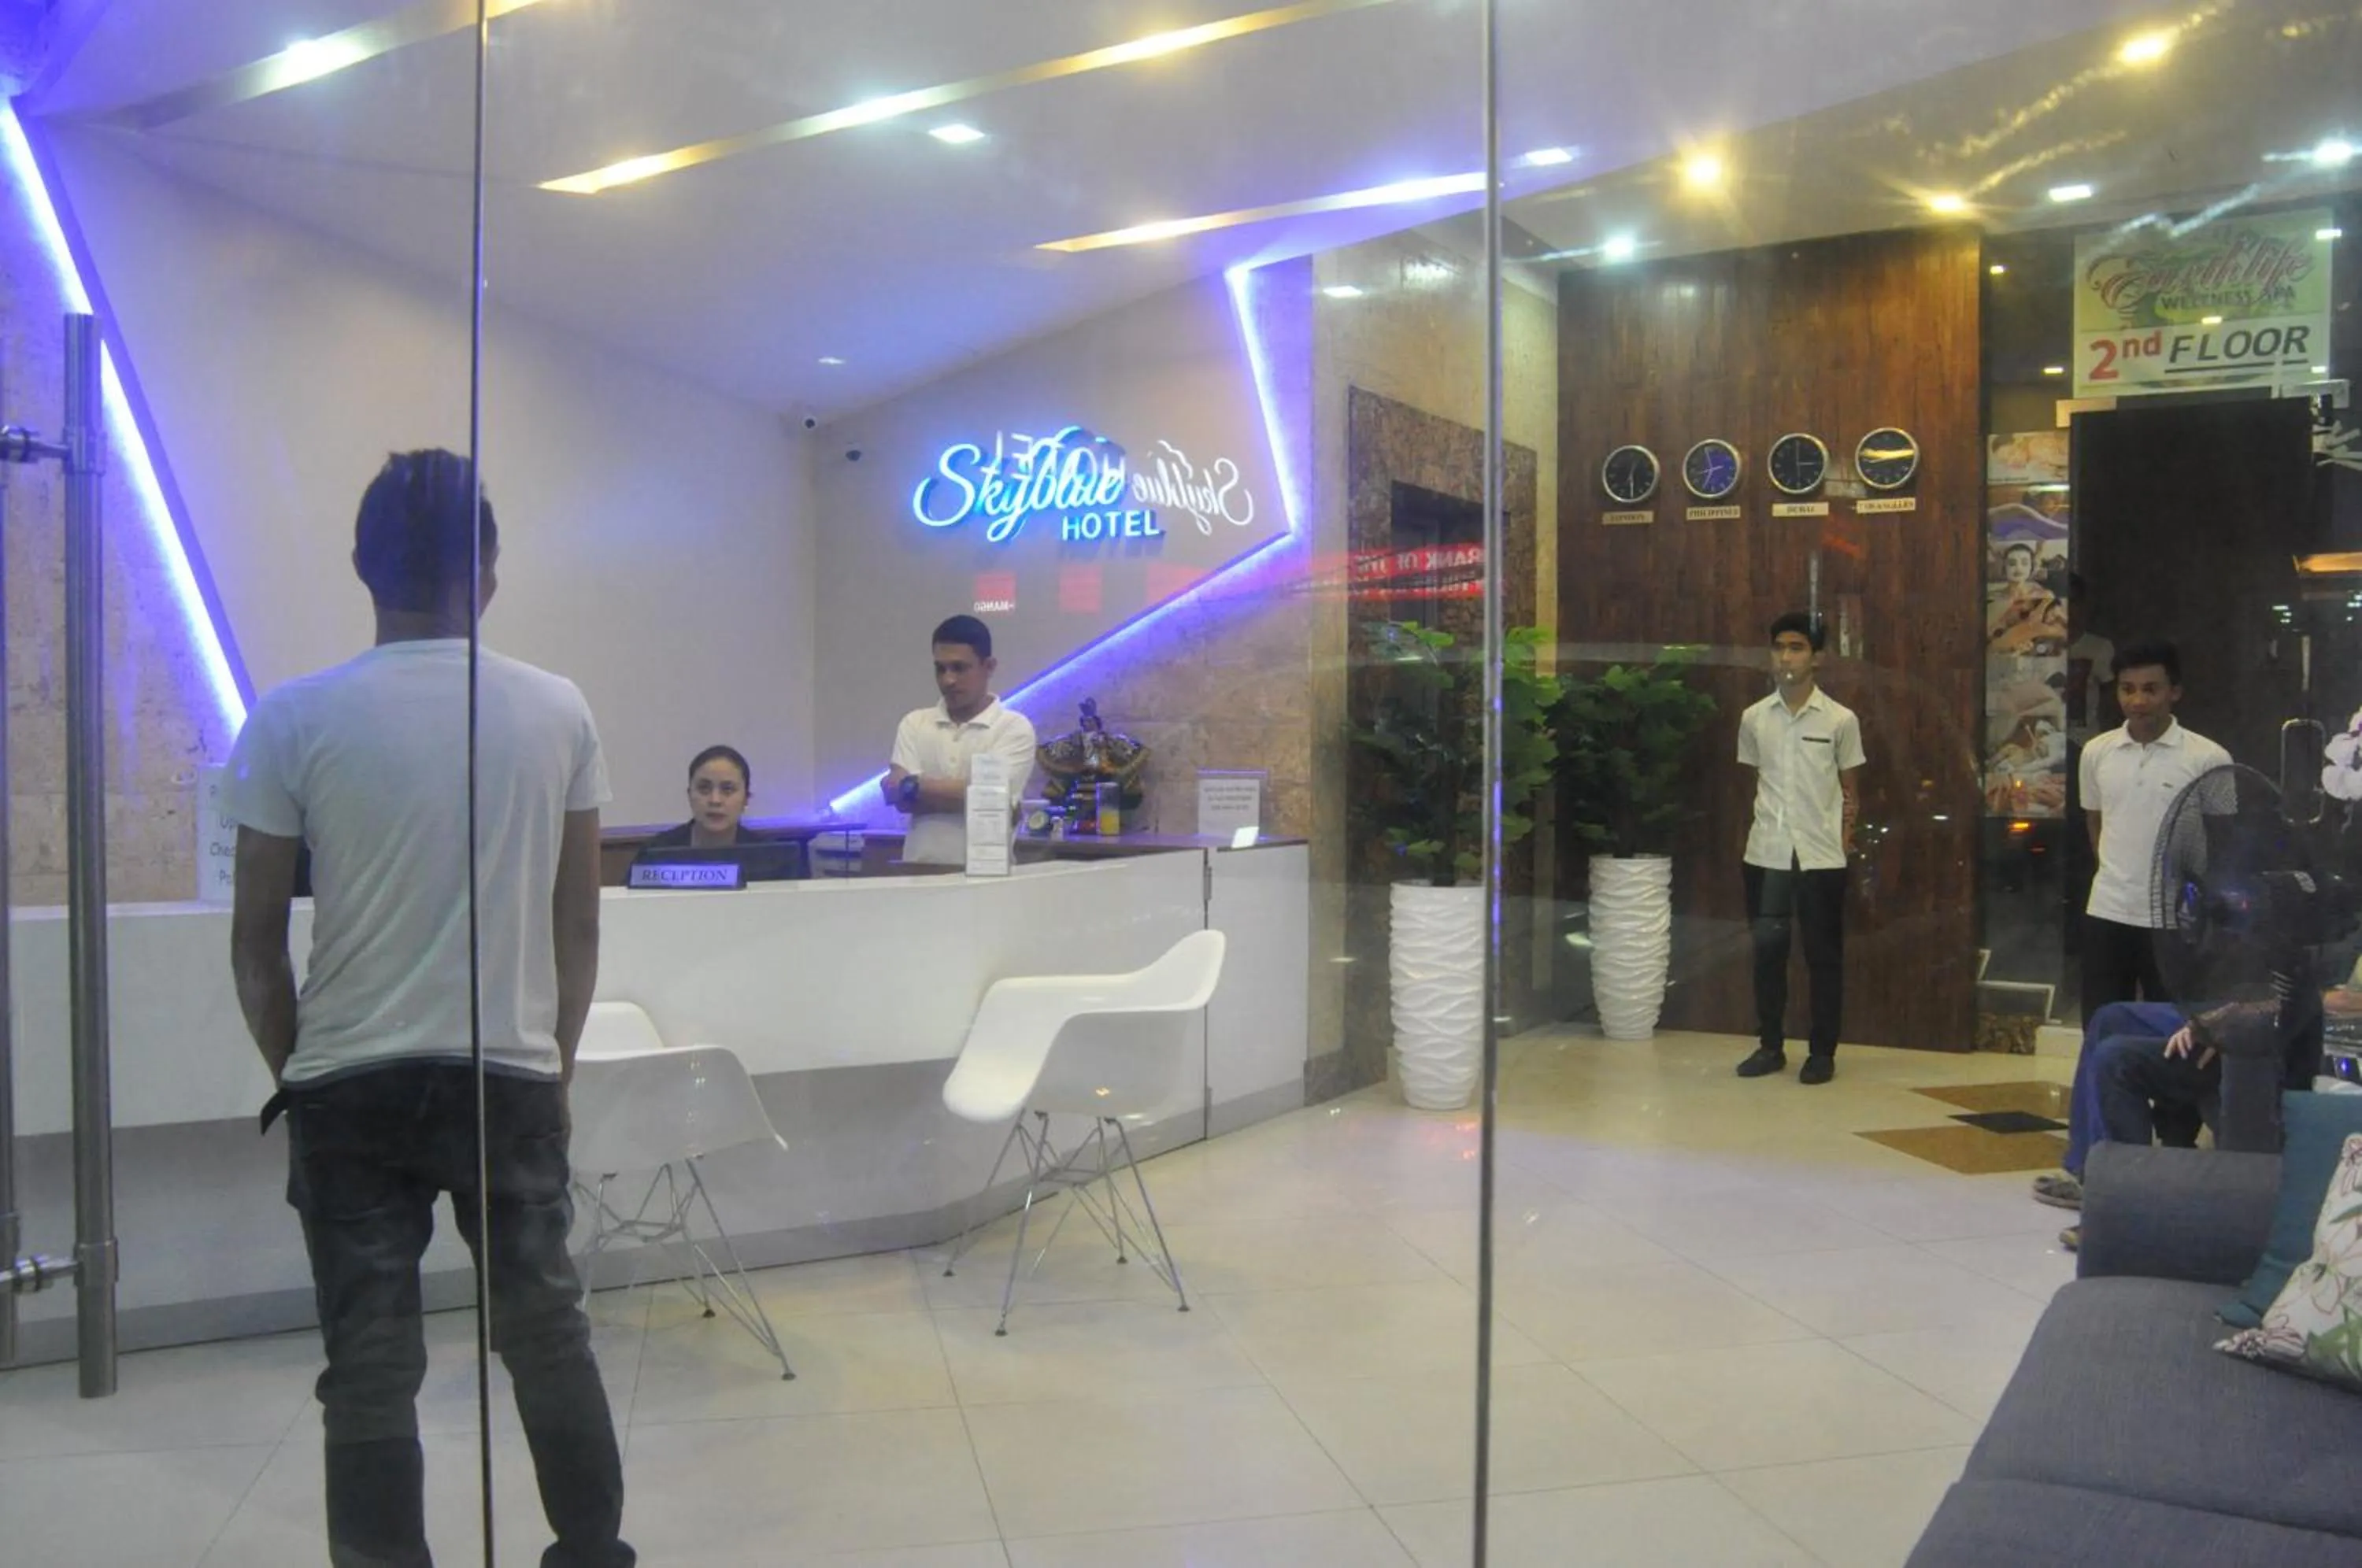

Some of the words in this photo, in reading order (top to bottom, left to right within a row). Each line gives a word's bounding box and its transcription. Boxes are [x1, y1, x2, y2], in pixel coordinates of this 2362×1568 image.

[2089, 331, 2161, 380] 2nd
[2168, 325, 2310, 363] FLOOR
[1062, 510, 1161, 541] HOTEL
[642, 868, 727, 882] RECEPTION
